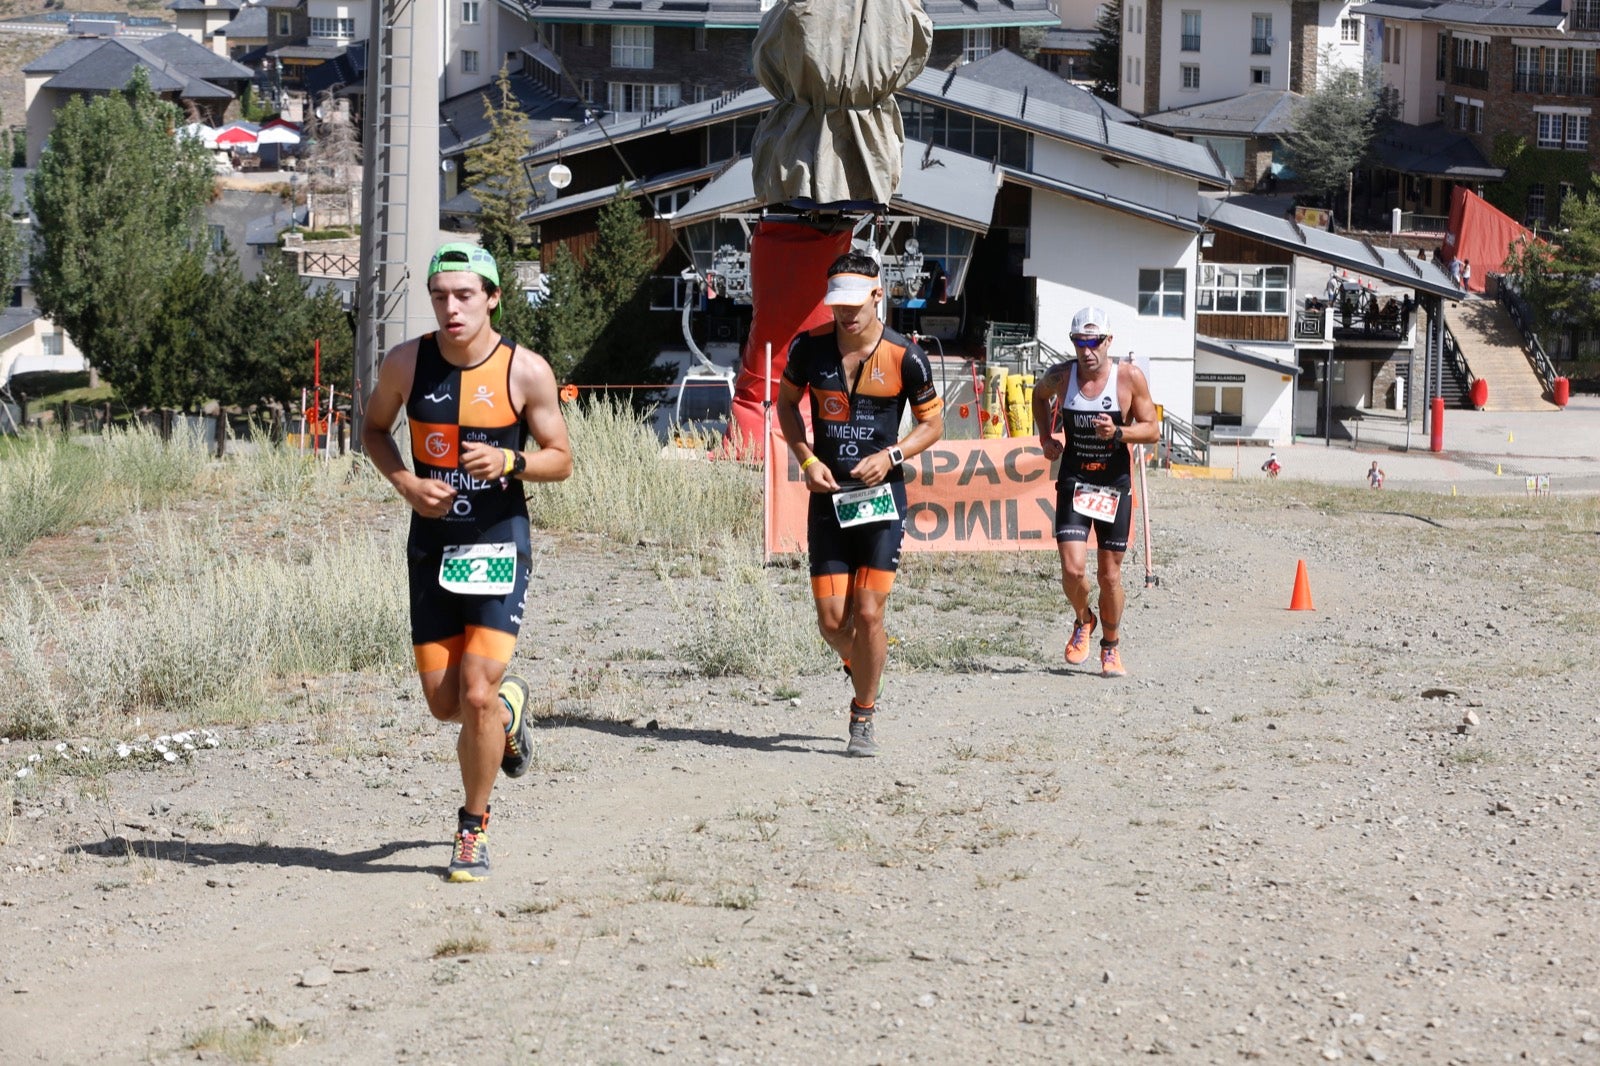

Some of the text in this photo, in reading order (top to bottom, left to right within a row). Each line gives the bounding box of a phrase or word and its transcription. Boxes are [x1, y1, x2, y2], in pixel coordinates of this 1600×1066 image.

[466, 431, 487, 441] club
[826, 423, 874, 441] JIMÉNEZ
[1077, 493, 1113, 515] 375
[468, 559, 489, 583] 2
